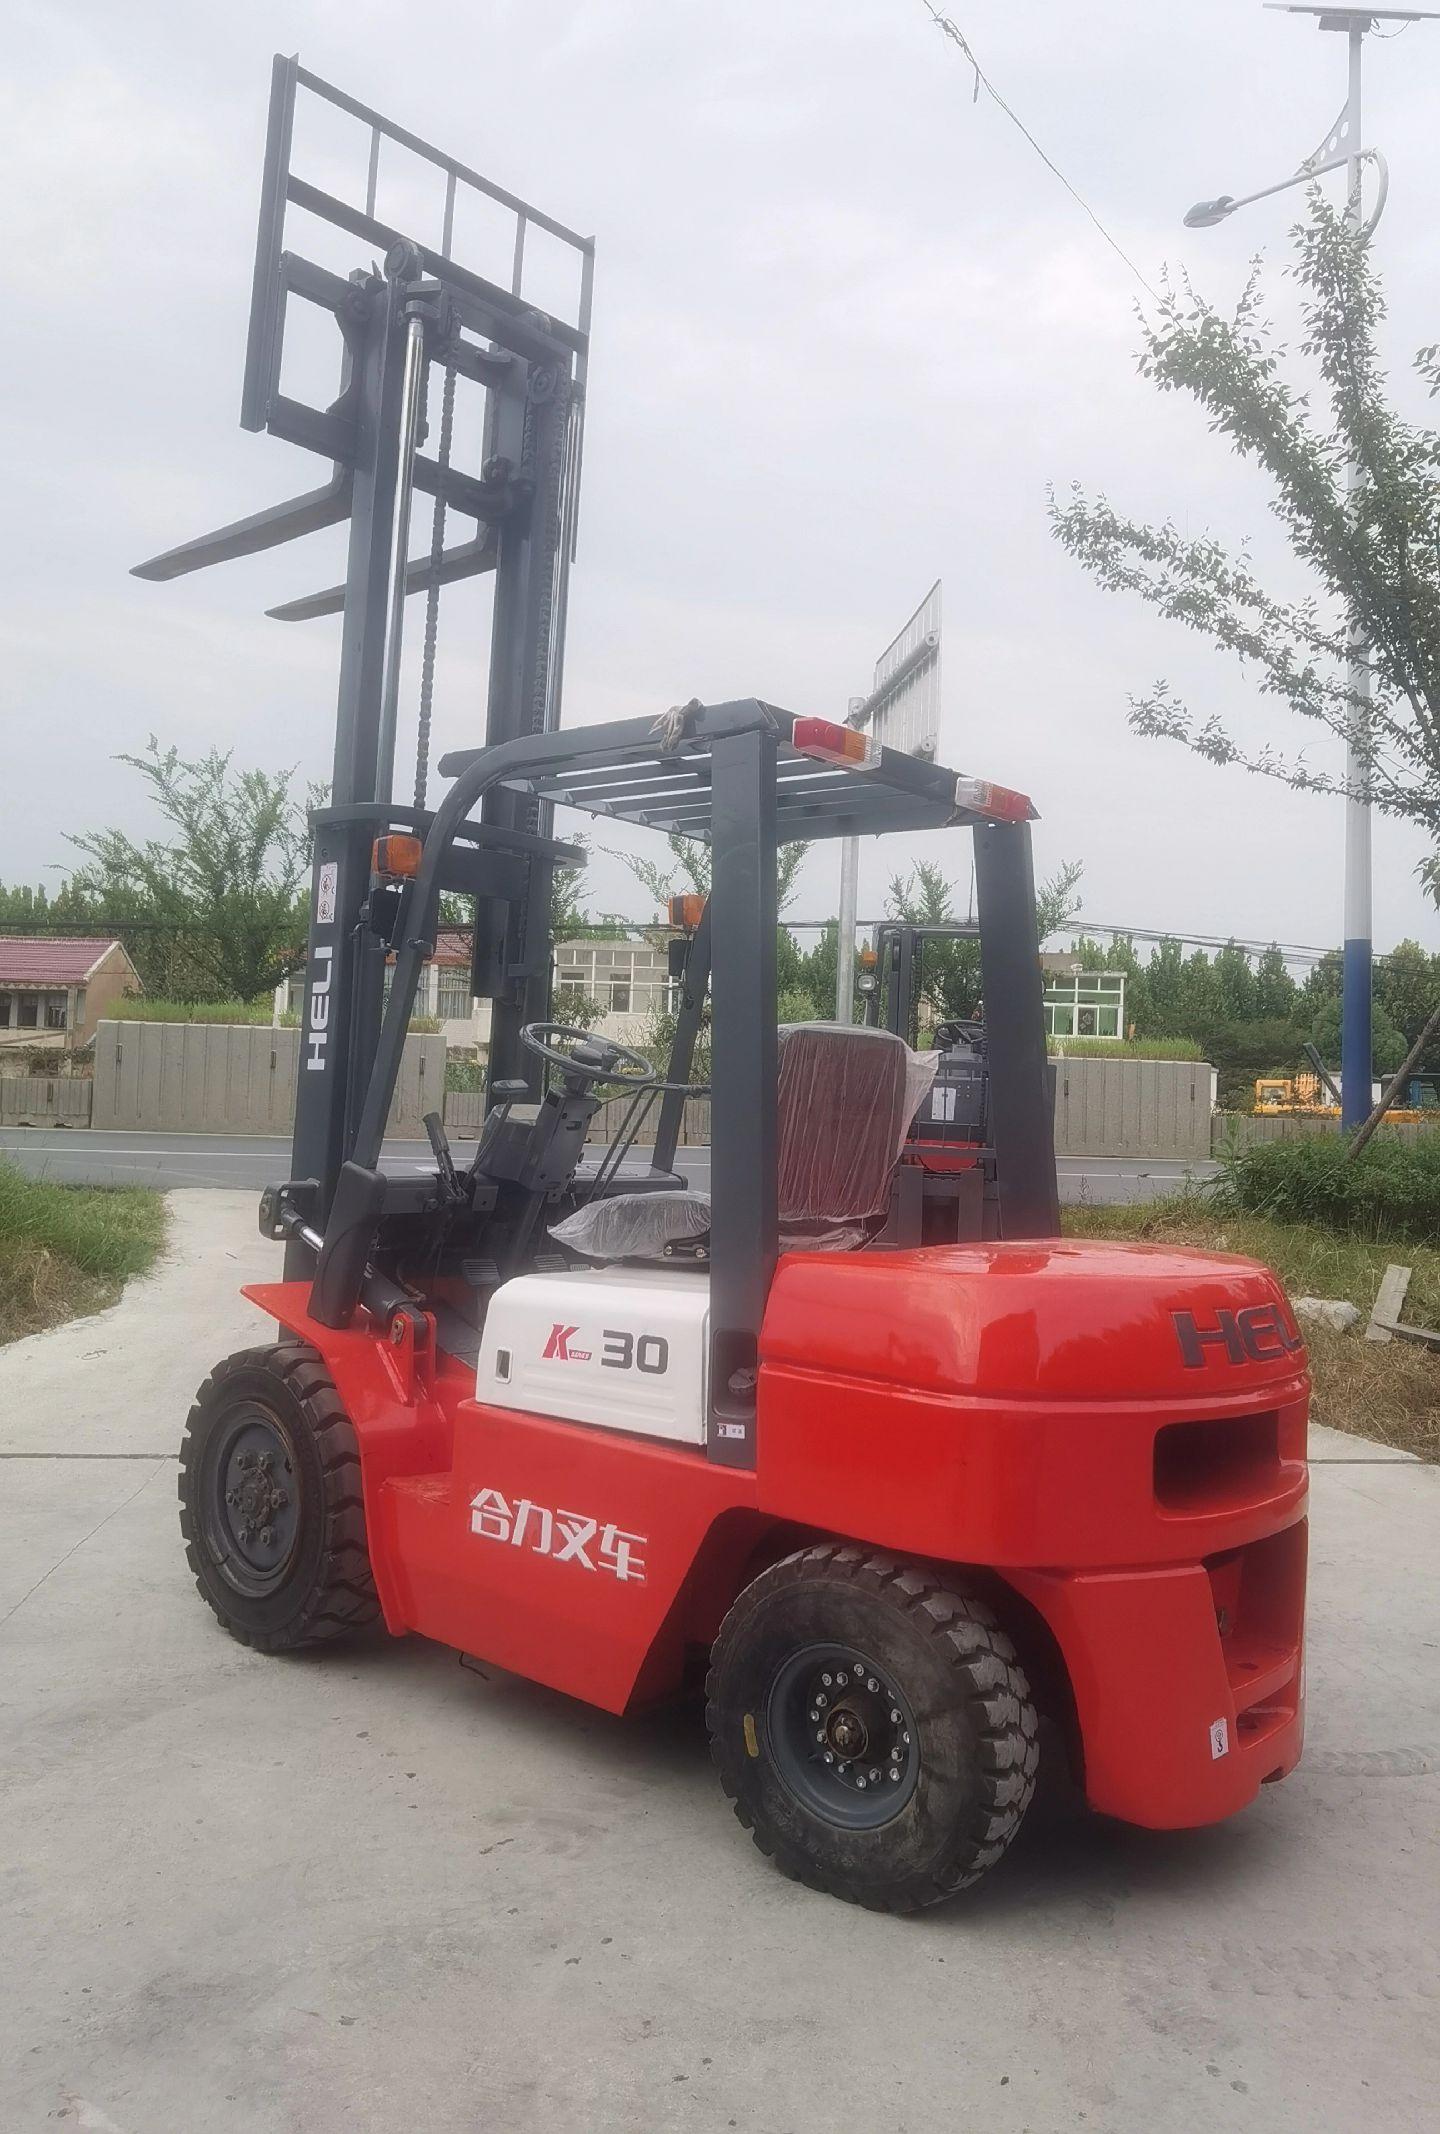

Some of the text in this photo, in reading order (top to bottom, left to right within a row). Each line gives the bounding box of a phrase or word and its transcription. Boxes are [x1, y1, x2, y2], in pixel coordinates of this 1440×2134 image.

[307, 947, 332, 1070] HELI
[542, 1324, 669, 1374] K 30
[1171, 1304, 1303, 1367] HEL
[469, 1487, 648, 1581] 合力叉车
